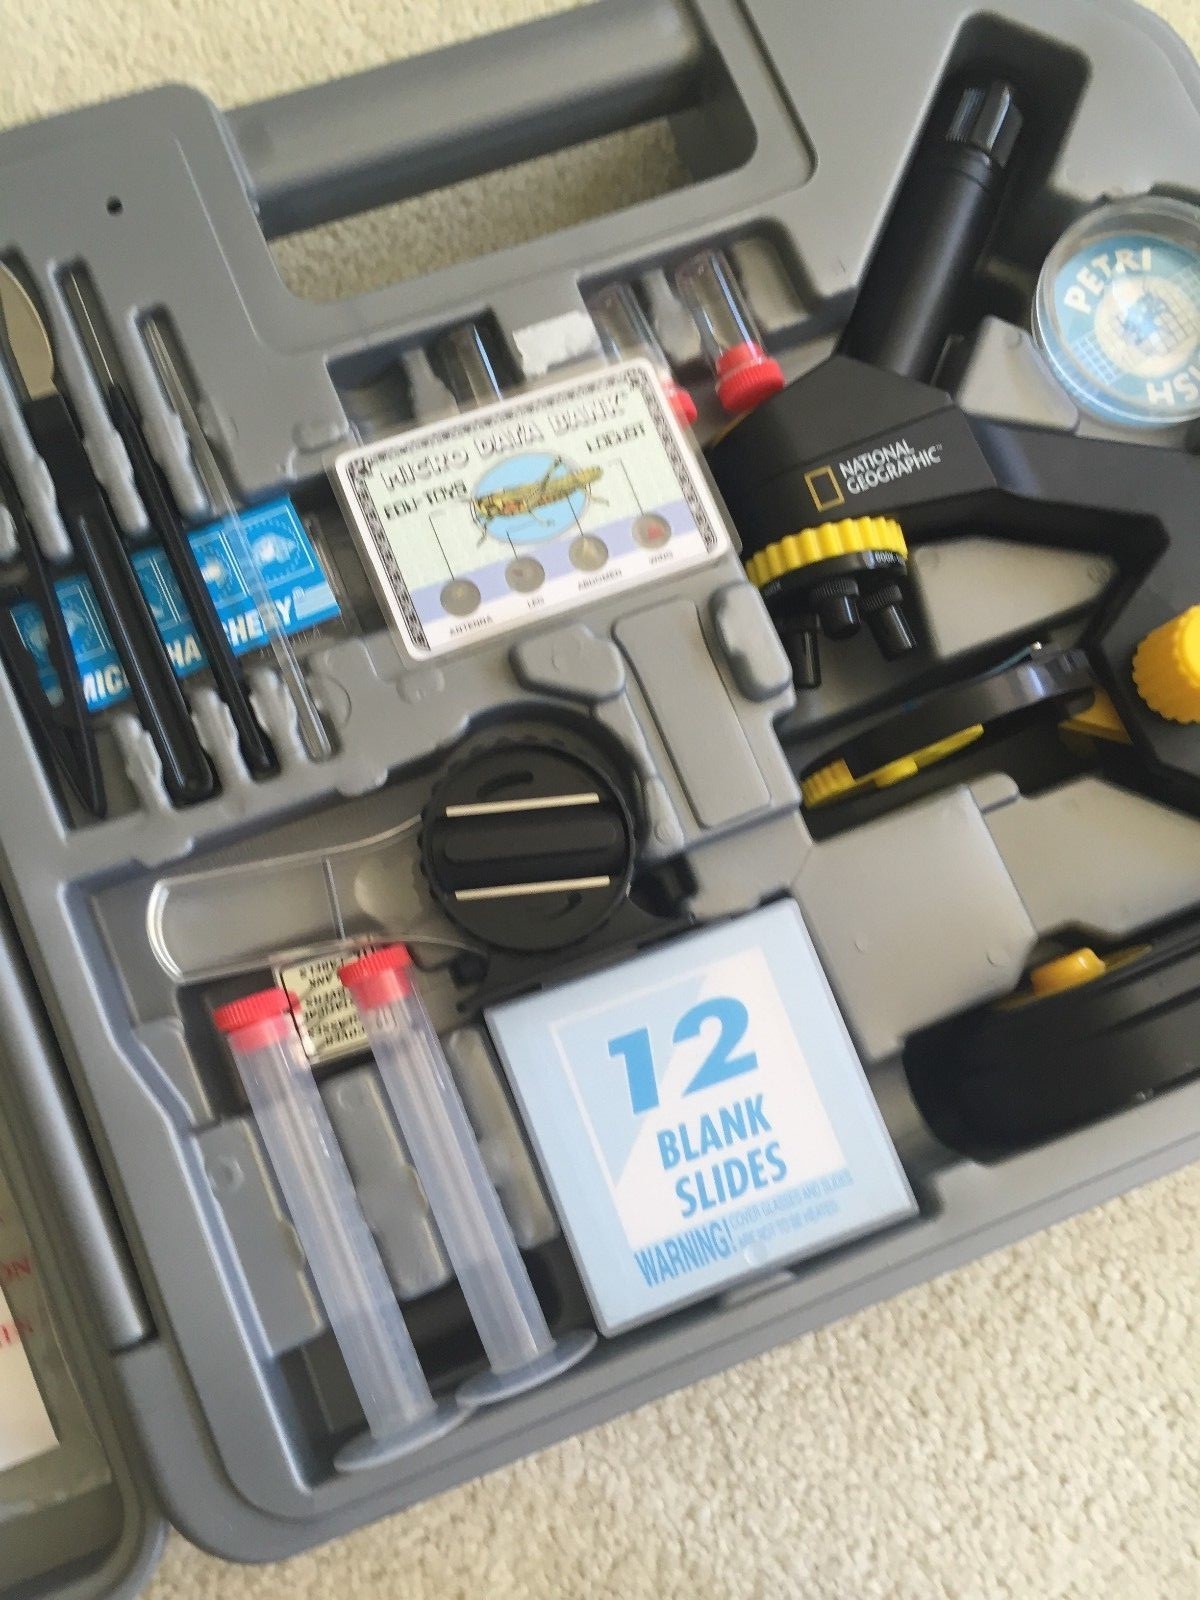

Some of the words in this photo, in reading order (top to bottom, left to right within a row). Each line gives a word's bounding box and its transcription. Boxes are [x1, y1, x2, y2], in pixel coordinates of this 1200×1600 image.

[1063, 247, 1152, 315] PETRI
[380, 447, 470, 491] MICRO
[474, 422, 545, 459] DATA
[548, 391, 627, 437] BANK
[839, 438, 915, 480] NATIONAL
[846, 444, 943, 495] GEOGRAPHIC
[608, 996, 758, 1116] 12
[656, 1093, 773, 1170] BLANK
[675, 1141, 787, 1219] SLIDES
[633, 1218, 738, 1289] WARNING!
